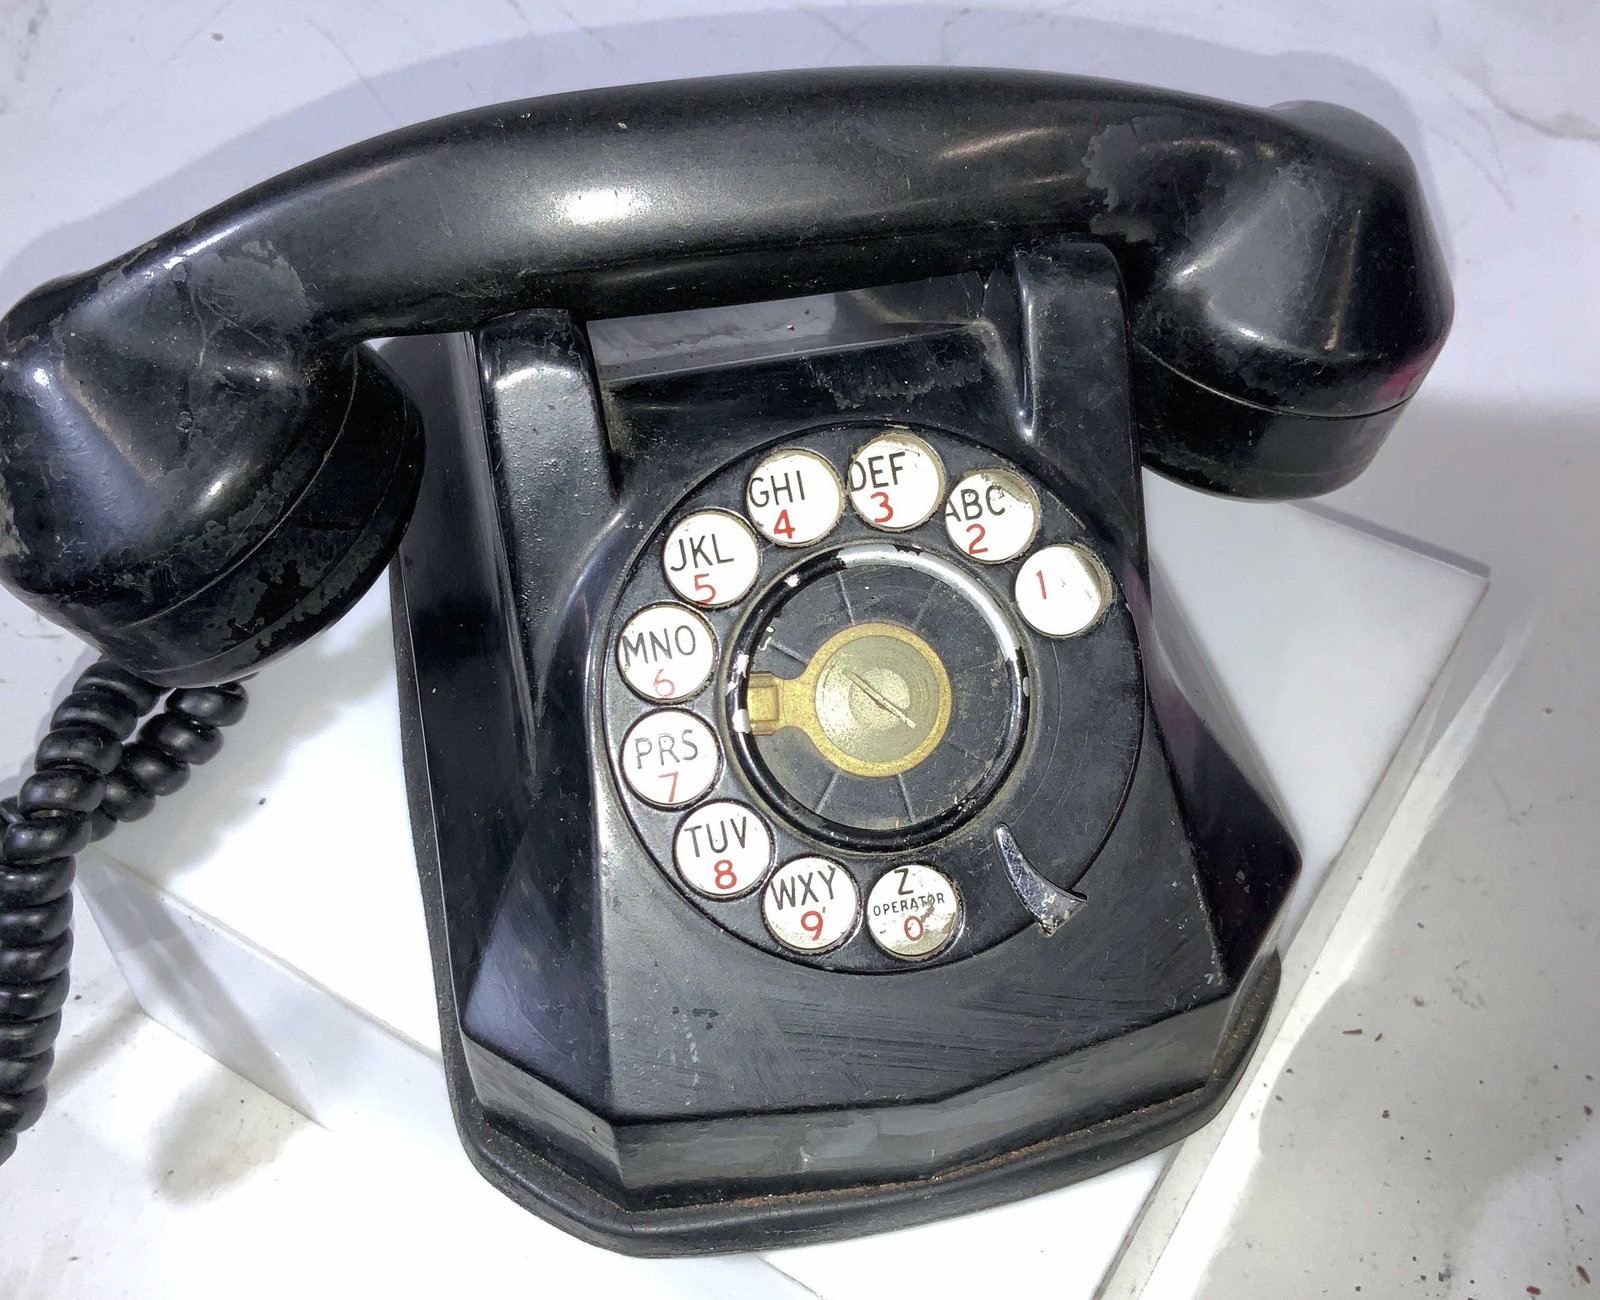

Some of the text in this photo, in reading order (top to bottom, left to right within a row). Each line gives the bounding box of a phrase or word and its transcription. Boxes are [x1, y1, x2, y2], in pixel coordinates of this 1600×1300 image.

[851, 452, 906, 492] DEF
[749, 470, 806, 508] GHI
[870, 492, 894, 523] 3
[773, 509, 796, 540] 4
[966, 523, 989, 555] 2
[670, 533, 735, 572] JKL
[693, 573, 717, 605] 5
[1035, 570, 1048, 600] 1
[621, 625, 697, 667] MNO
[653, 669, 676, 698] 6
[634, 729, 699, 769] PRS
[658, 771, 680, 802] 7
[684, 816, 747, 858] TUV
[713, 859, 738, 890] 8
[770, 864, 836, 911] WXY
[894, 867, 915, 896] Z
[872, 892, 946, 917] OPERATOR
[800, 910, 824, 941] 9
[903, 915, 925, 942] 0
